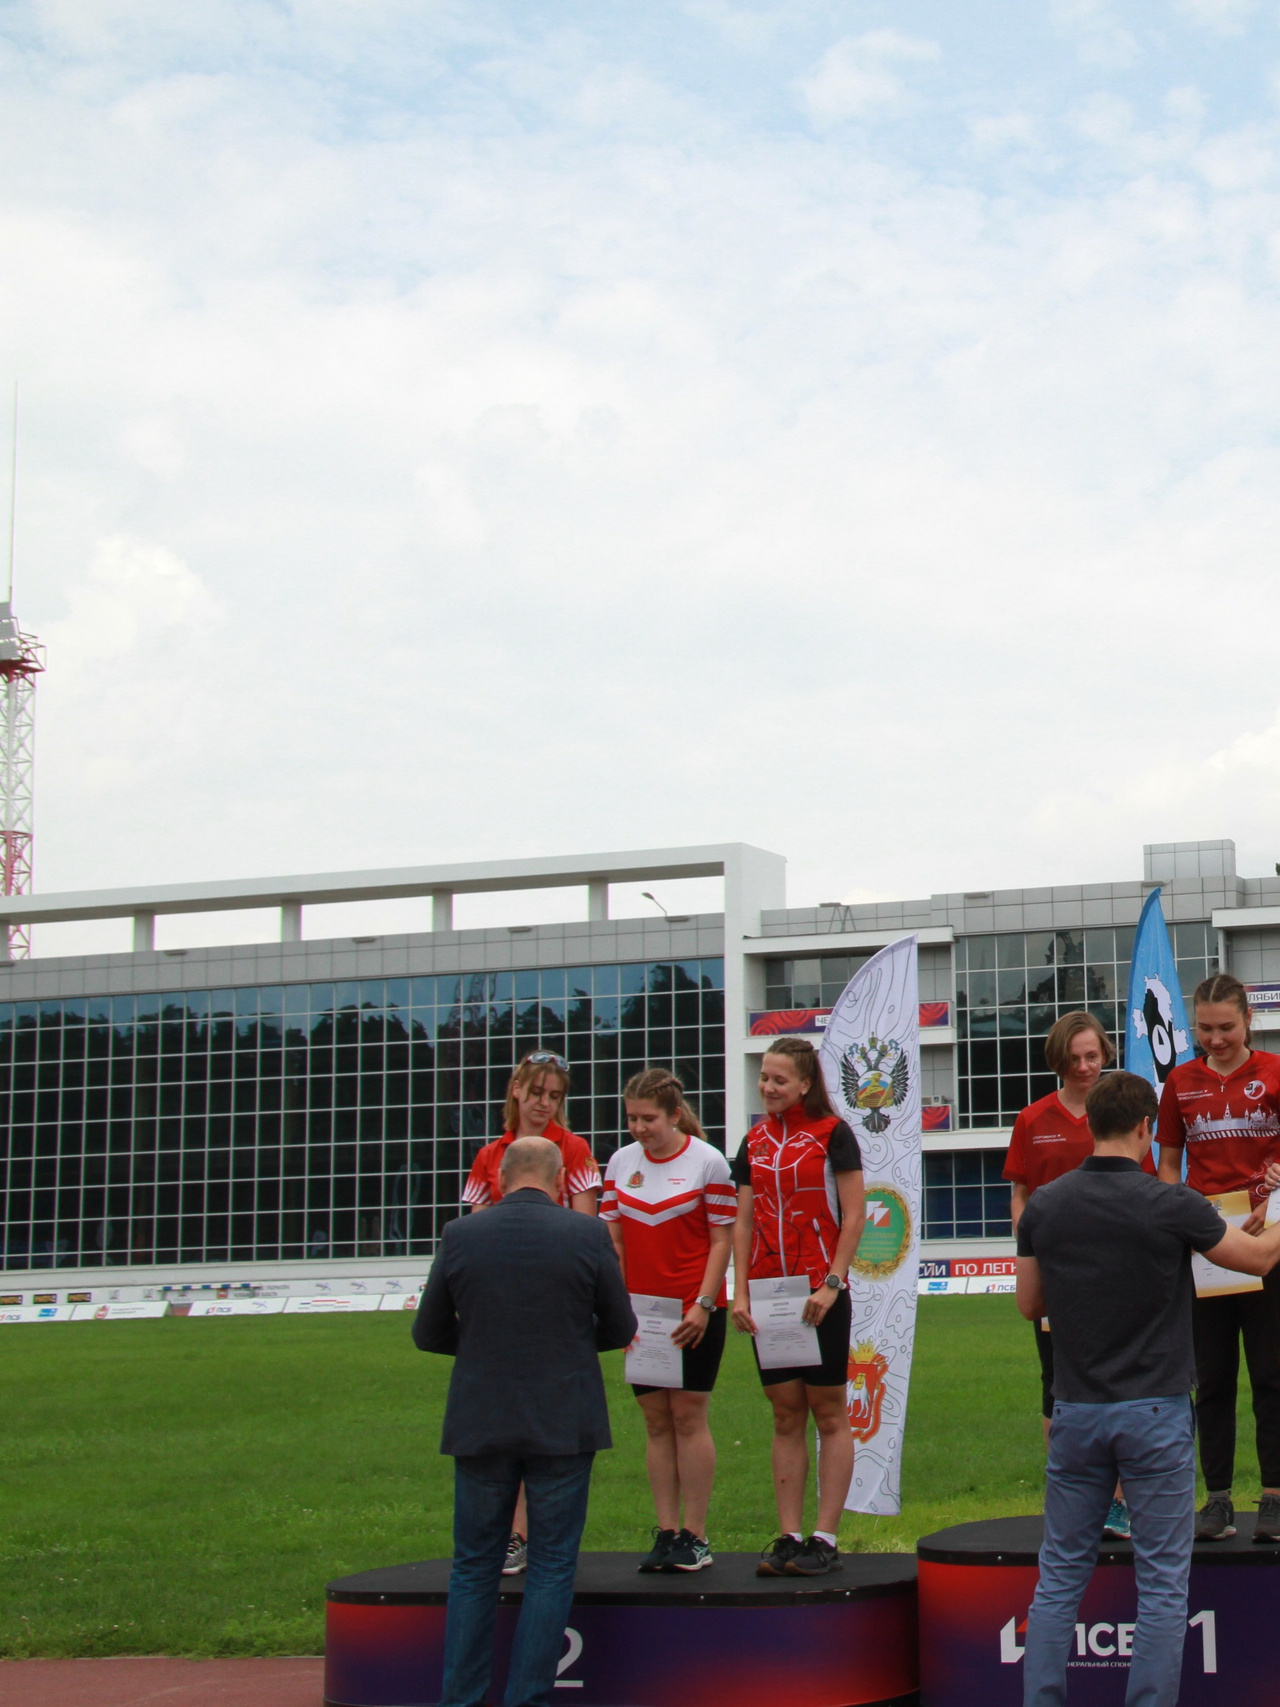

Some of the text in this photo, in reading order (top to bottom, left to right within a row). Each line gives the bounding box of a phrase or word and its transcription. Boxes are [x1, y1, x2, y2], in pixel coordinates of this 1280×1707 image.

[955, 1263, 978, 1275] ПО
[553, 1627, 583, 1687] 2
[1188, 1610, 1217, 1673] 1
